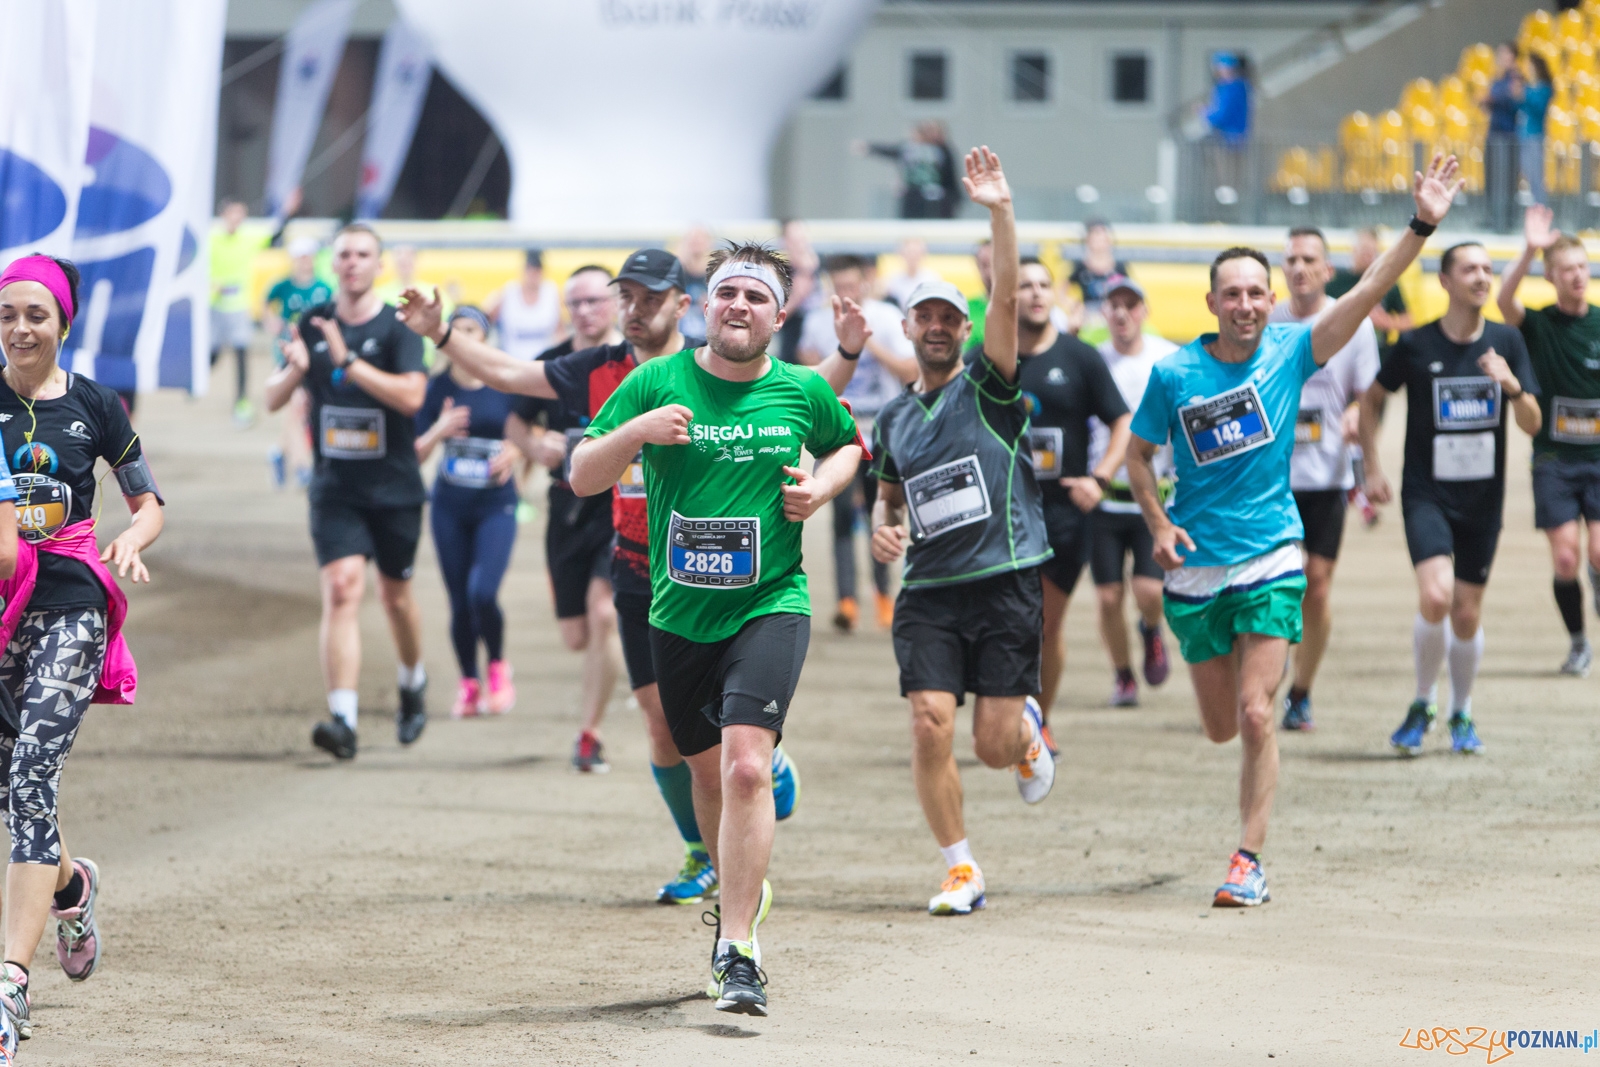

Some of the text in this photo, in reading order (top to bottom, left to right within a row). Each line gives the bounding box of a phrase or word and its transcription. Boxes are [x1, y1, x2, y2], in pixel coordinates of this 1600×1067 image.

[693, 424, 792, 444] SIĘGAJ NIEBA
[1211, 419, 1244, 446] 142
[734, 449, 753, 457] TOWER
[936, 497, 955, 516] 87
[684, 551, 733, 574] 2826
